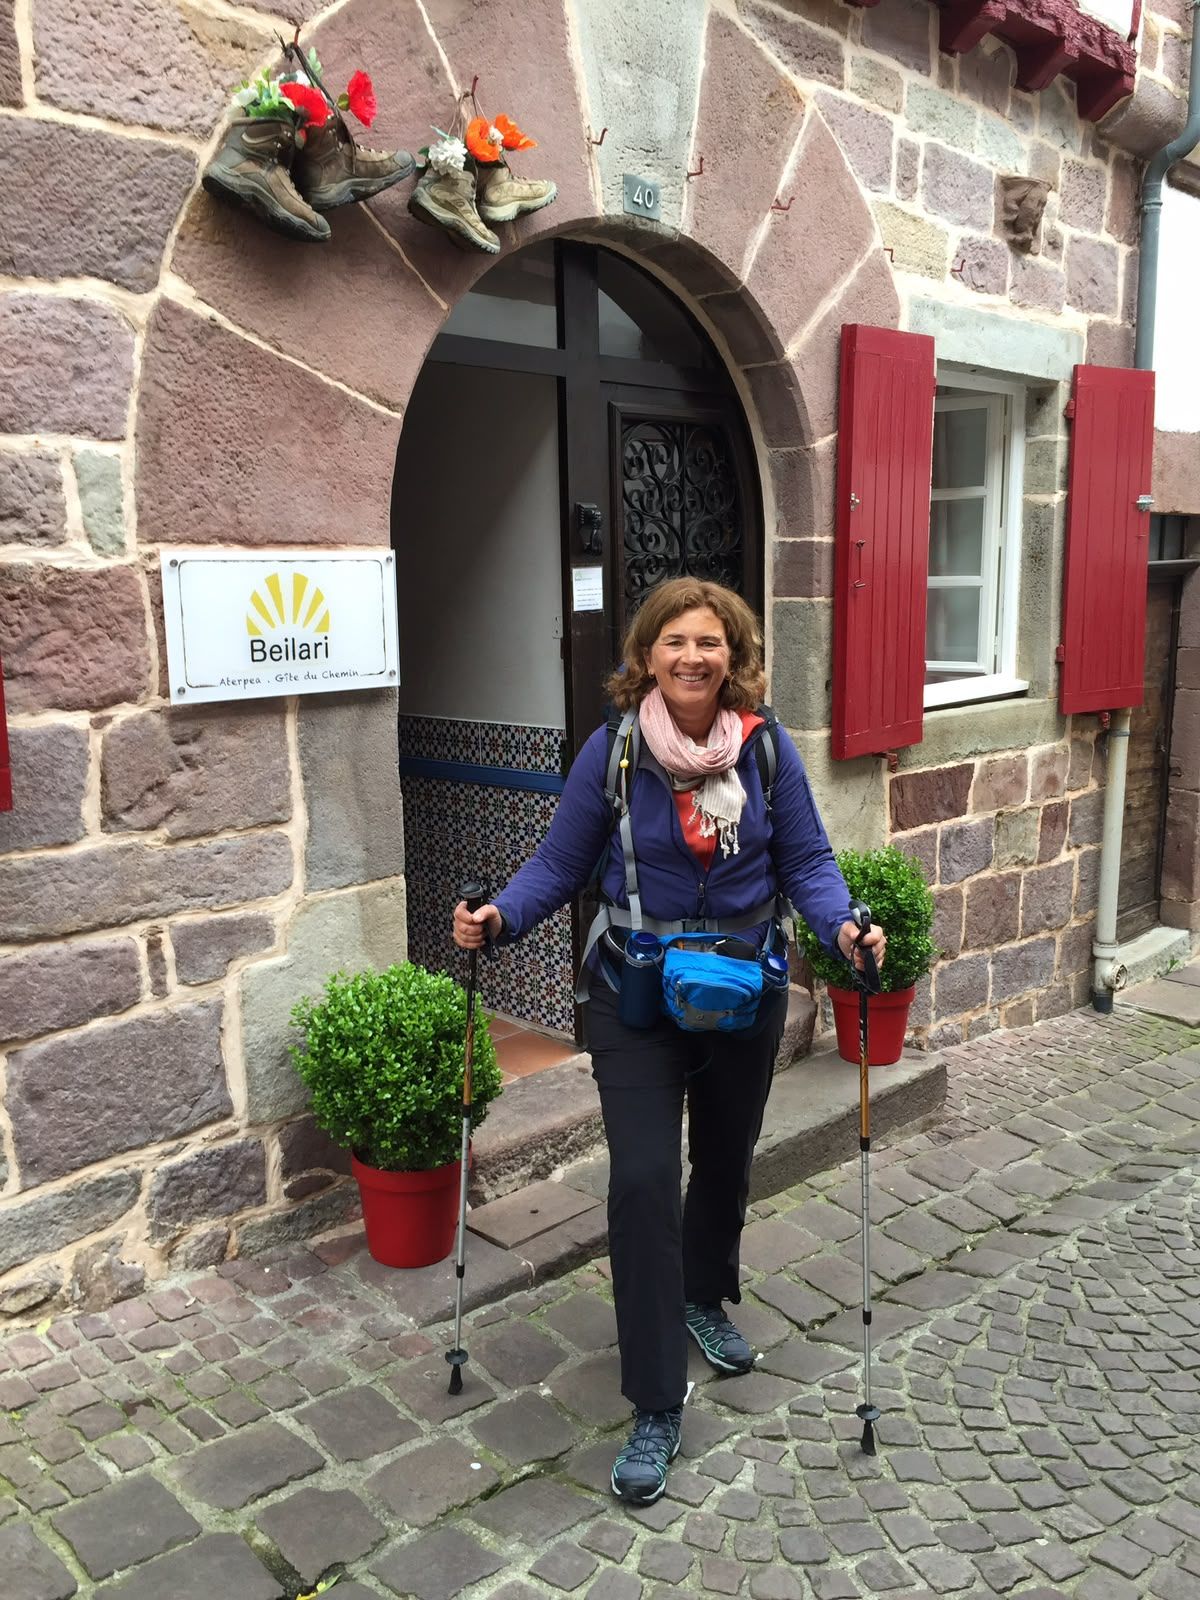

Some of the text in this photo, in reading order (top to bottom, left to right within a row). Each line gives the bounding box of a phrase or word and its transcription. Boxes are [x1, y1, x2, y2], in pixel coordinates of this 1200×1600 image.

[633, 185, 654, 209] 40
[250, 635, 329, 663] Beilari
[219, 668, 359, 690] Aterpea Gîte du Chemin
